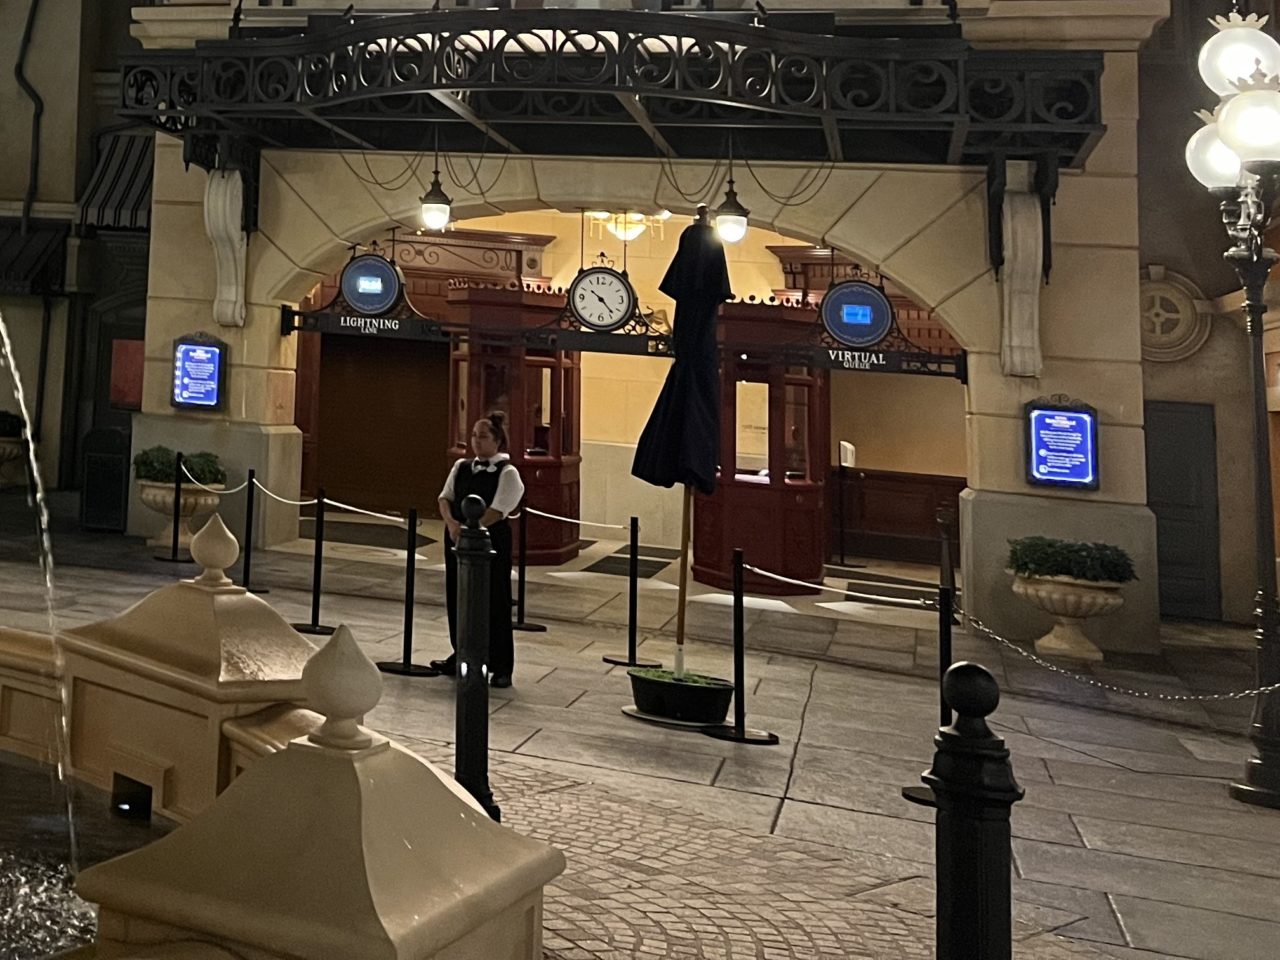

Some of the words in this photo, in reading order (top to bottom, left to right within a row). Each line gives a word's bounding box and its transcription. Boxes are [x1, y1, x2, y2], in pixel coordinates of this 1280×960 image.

[596, 276, 607, 286] 12
[578, 293, 585, 302] 9
[618, 295, 624, 305] 3
[597, 313, 605, 322] 6
[340, 316, 400, 330] LIGHTNING
[361, 326, 378, 334] LANE
[828, 349, 887, 365] VIRTUAL
[843, 360, 871, 370] QUEUE
